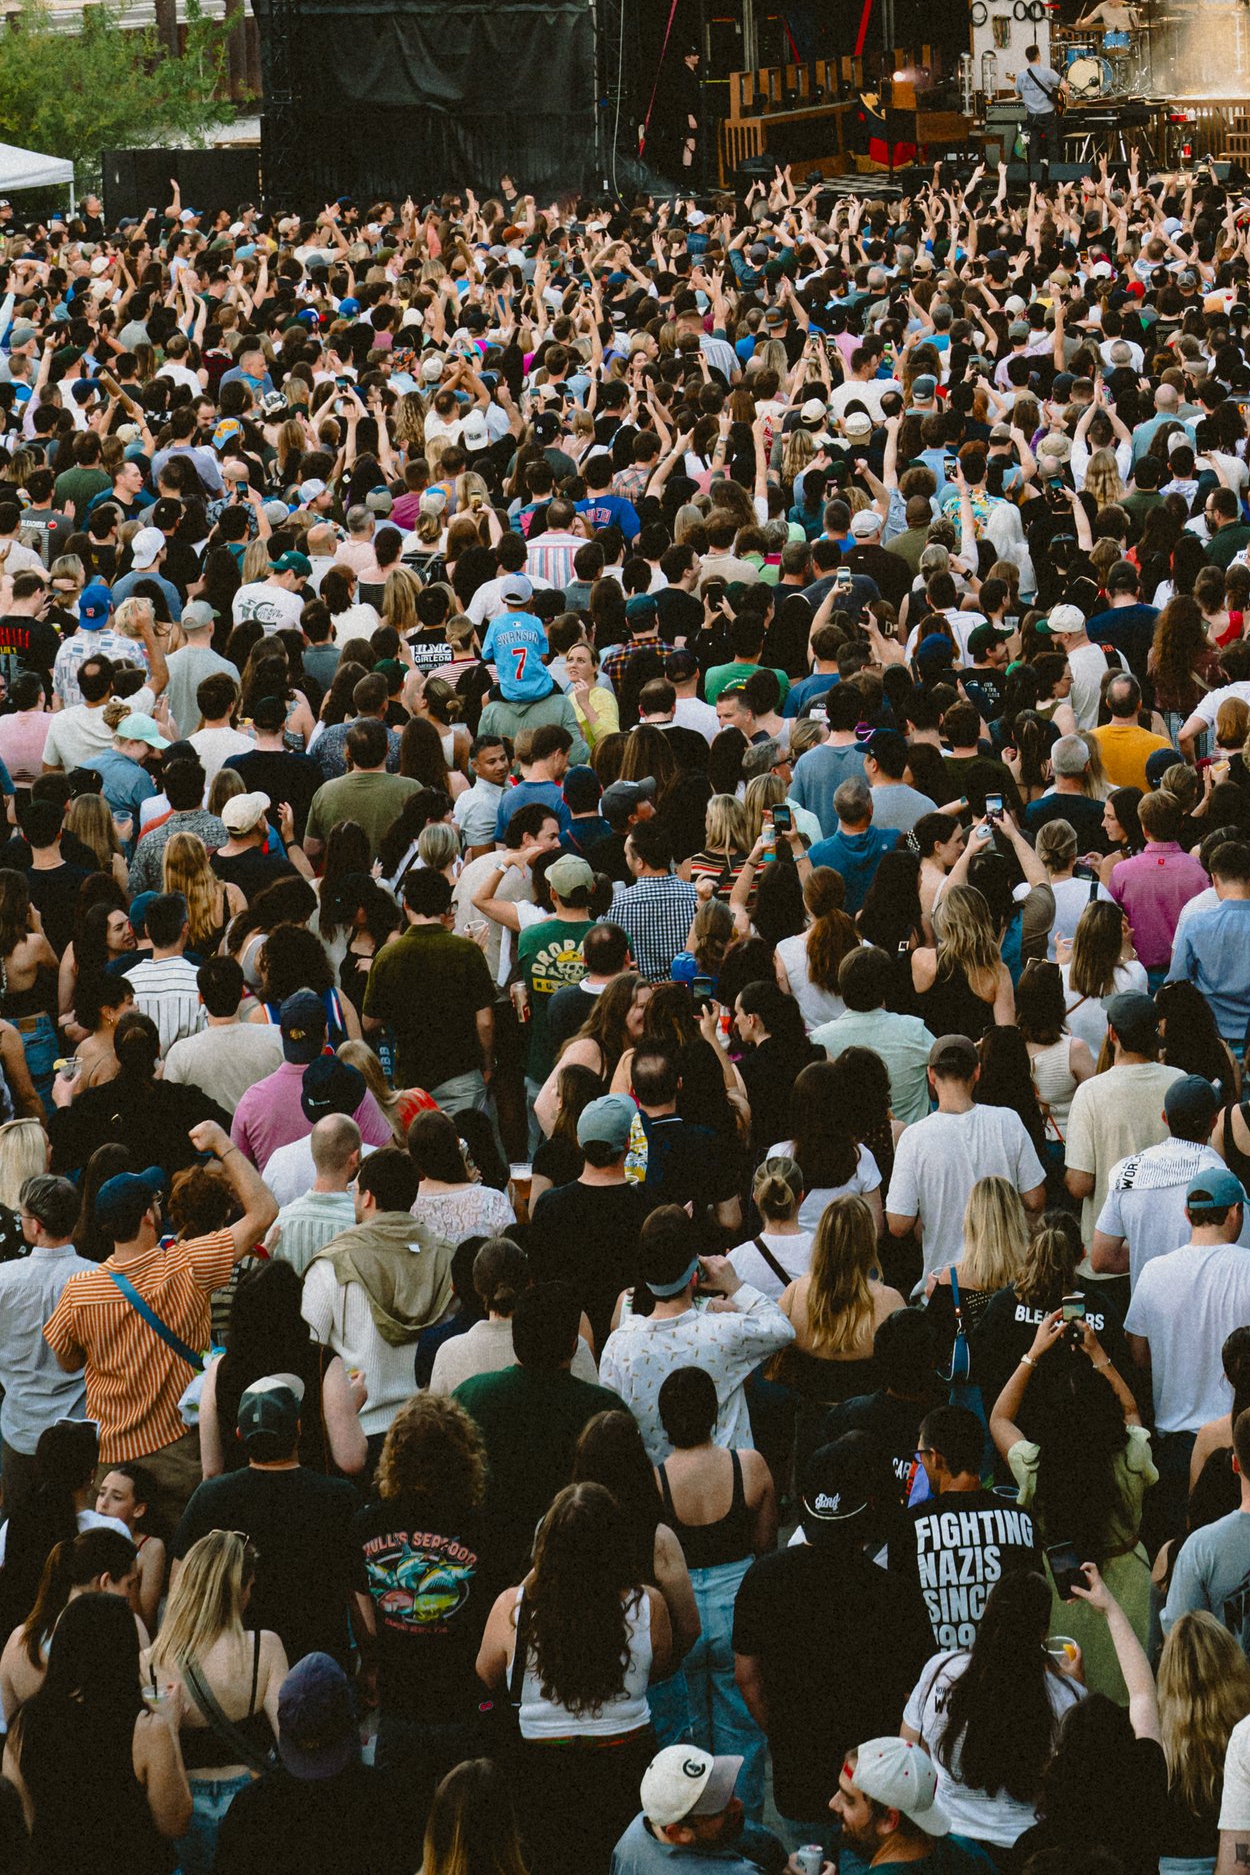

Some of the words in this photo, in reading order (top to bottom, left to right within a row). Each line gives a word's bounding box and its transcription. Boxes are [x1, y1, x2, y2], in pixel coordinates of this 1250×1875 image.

[495, 630, 538, 648] SWANSON
[510, 648, 526, 680] 7
[914, 1509, 1034, 1553] FIGHTING
[917, 1545, 1002, 1589] NAZIS
